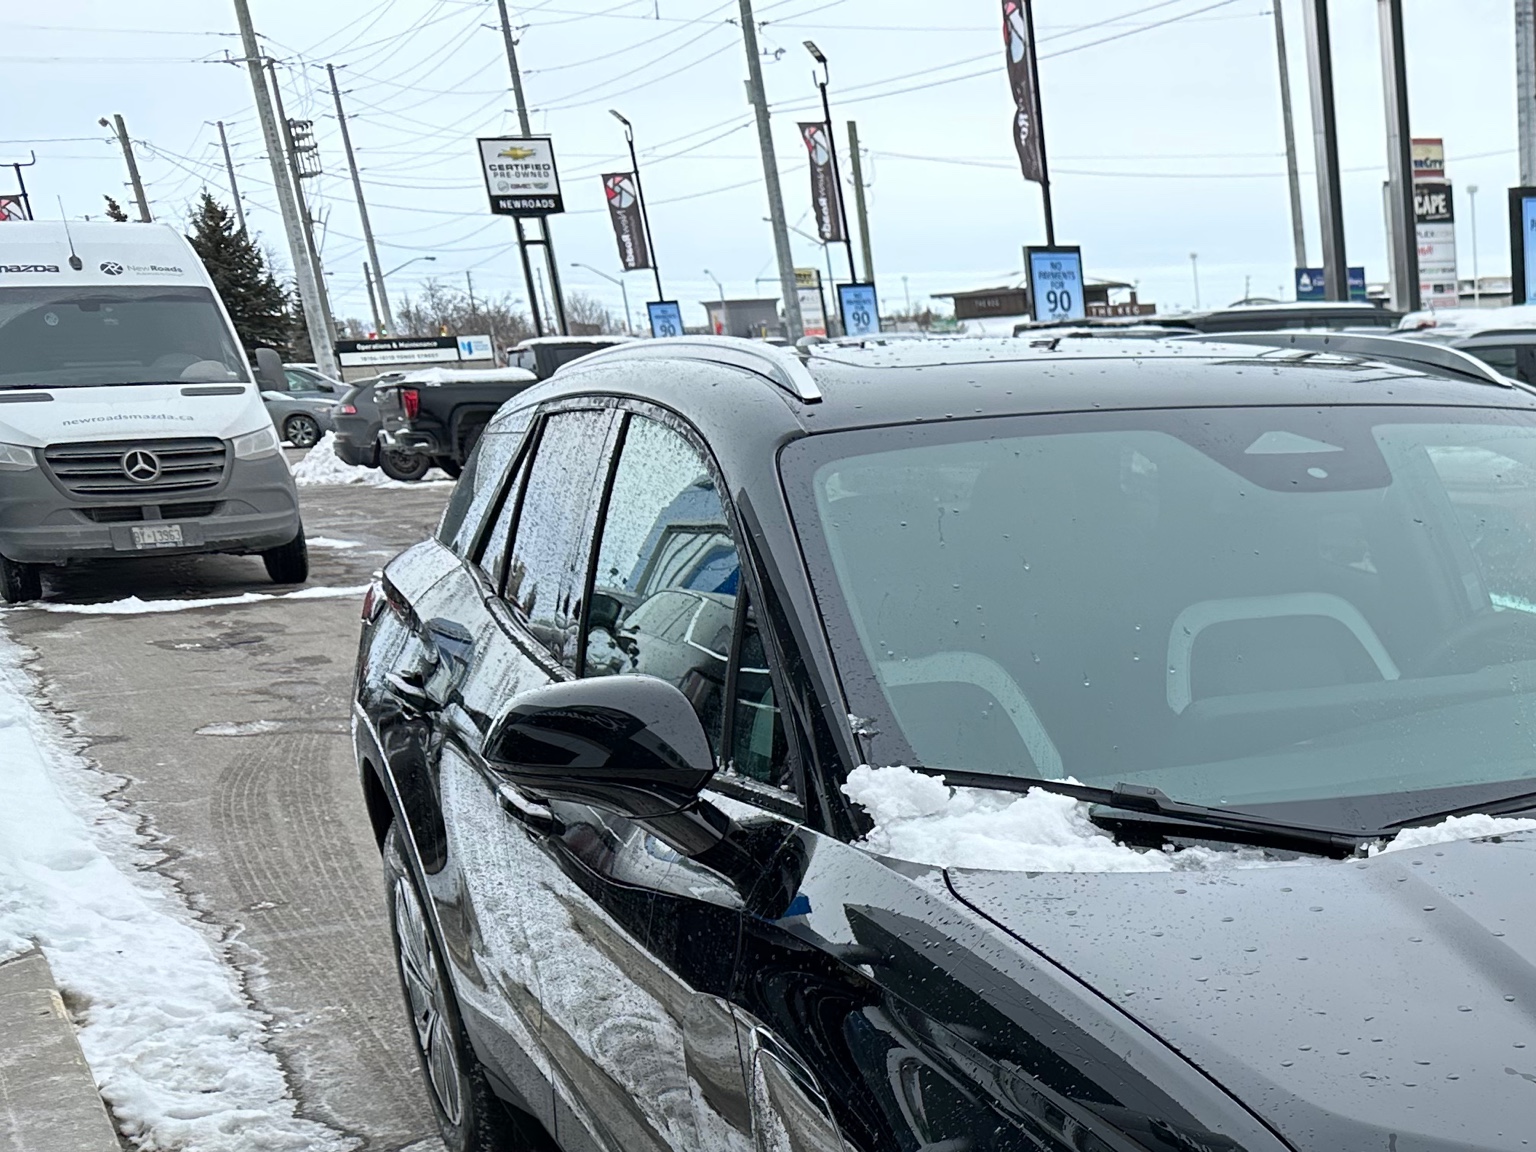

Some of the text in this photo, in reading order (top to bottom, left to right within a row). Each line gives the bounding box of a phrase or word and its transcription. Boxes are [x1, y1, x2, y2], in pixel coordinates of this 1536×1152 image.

[488, 163, 551, 171] CERTIFIED
[499, 199, 556, 209] NEWROADS
[1413, 193, 1448, 216] CAPE
[1046, 290, 1072, 313] 90
[1091, 306, 1141, 316] THE KEG
[852, 310, 871, 327] 90
[659, 323, 677, 338] 90
[62, 413, 195, 427] newroadsmazda.ca
